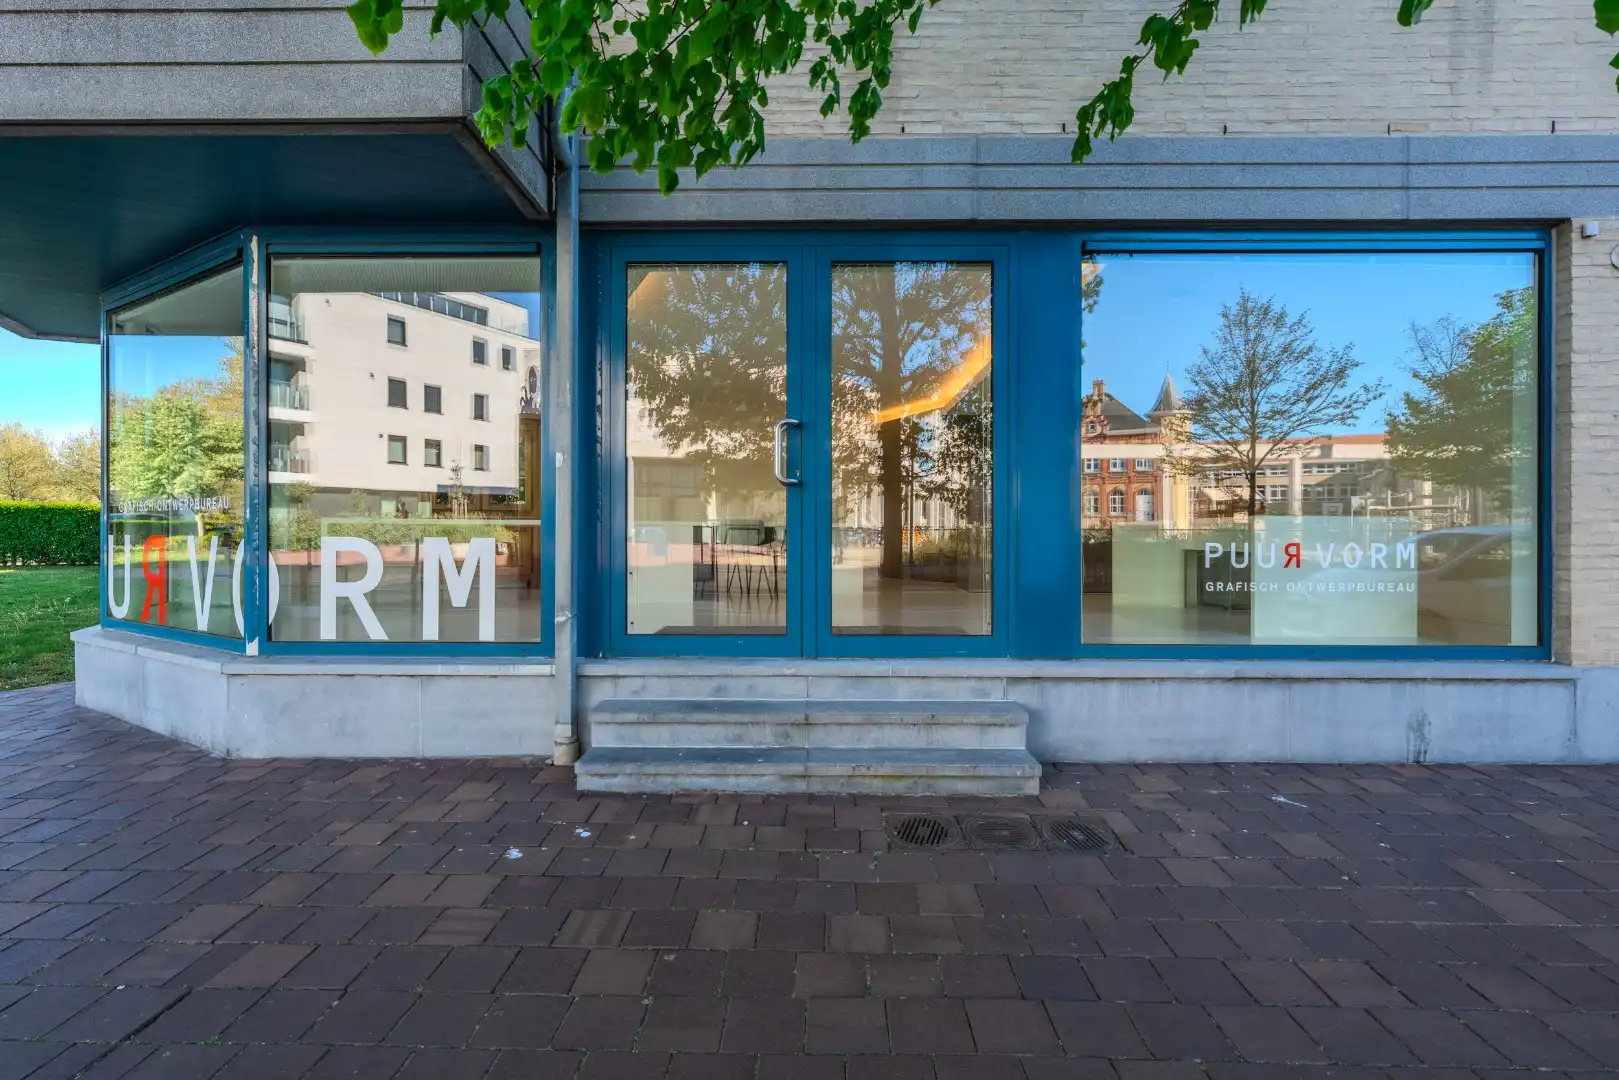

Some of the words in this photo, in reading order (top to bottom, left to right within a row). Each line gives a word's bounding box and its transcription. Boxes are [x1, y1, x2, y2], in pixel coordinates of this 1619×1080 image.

[157, 497, 230, 511] ONTWERPBUREAU
[1316, 542, 1416, 569] VORM
[1205, 581, 1279, 592] GRAFISCH
[1286, 581, 1416, 592] ONTWERPBUREAU
